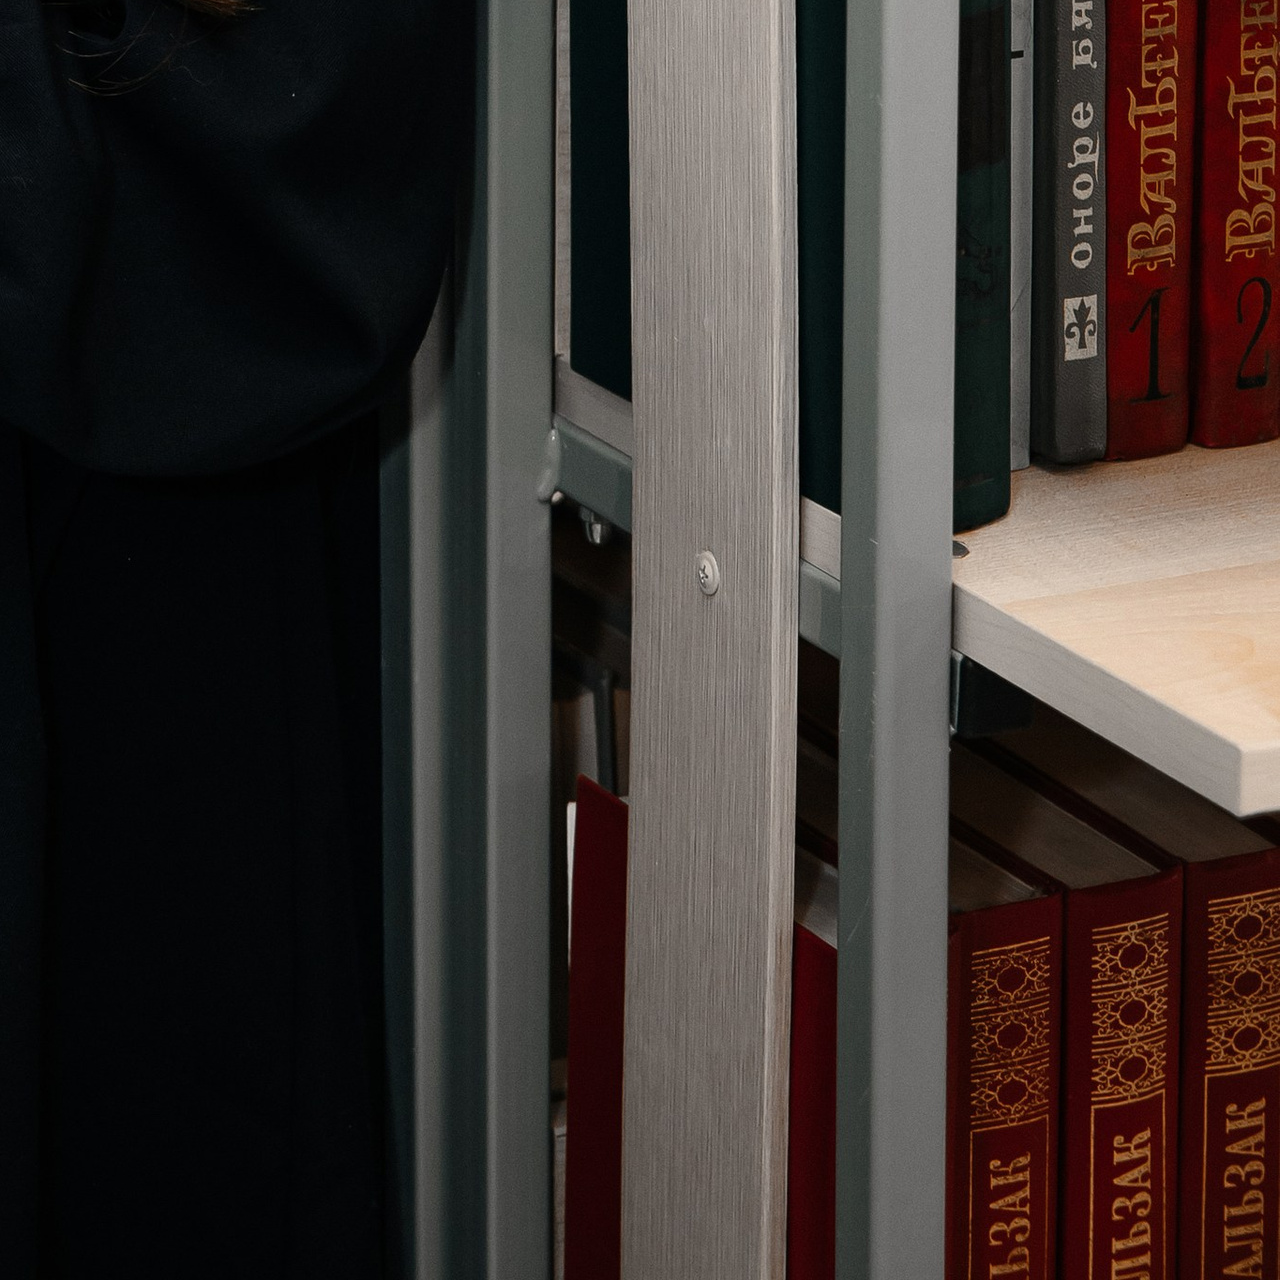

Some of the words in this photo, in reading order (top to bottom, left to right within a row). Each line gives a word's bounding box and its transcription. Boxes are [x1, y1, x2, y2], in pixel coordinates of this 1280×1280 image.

[1129, 287, 1172, 403] 1
[1236, 276, 1271, 390] 2
[989, 1151, 1031, 1280] ЬЗАК
